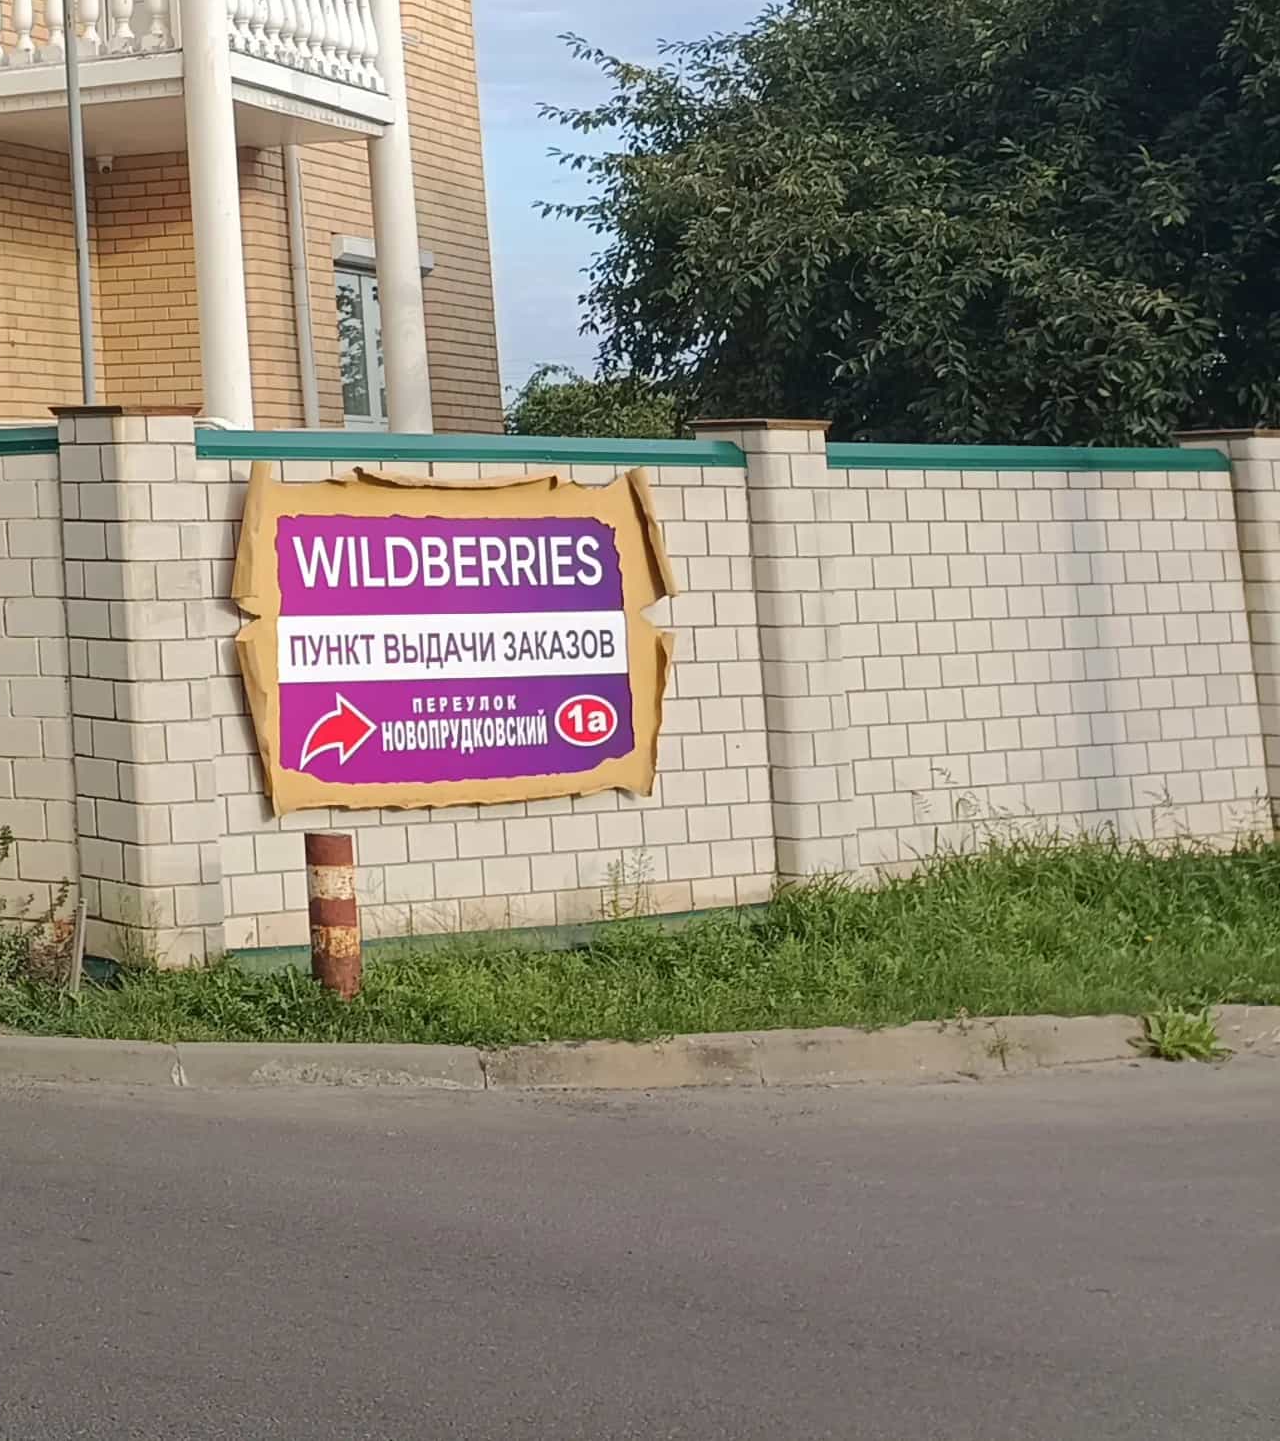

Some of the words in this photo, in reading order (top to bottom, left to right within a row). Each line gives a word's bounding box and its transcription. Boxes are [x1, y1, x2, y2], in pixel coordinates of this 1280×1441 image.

[292, 535, 603, 588] WILDBERRIES
[289, 634, 375, 666] ПУНКТ
[384, 630, 495, 669] ВЫДАЧИ
[503, 629, 615, 661] ЗАКАЗОВ
[412, 694, 517, 714] ПЕРЕУЛОК
[381, 710, 548, 753] НОВОПРУДКОВСКИЙ
